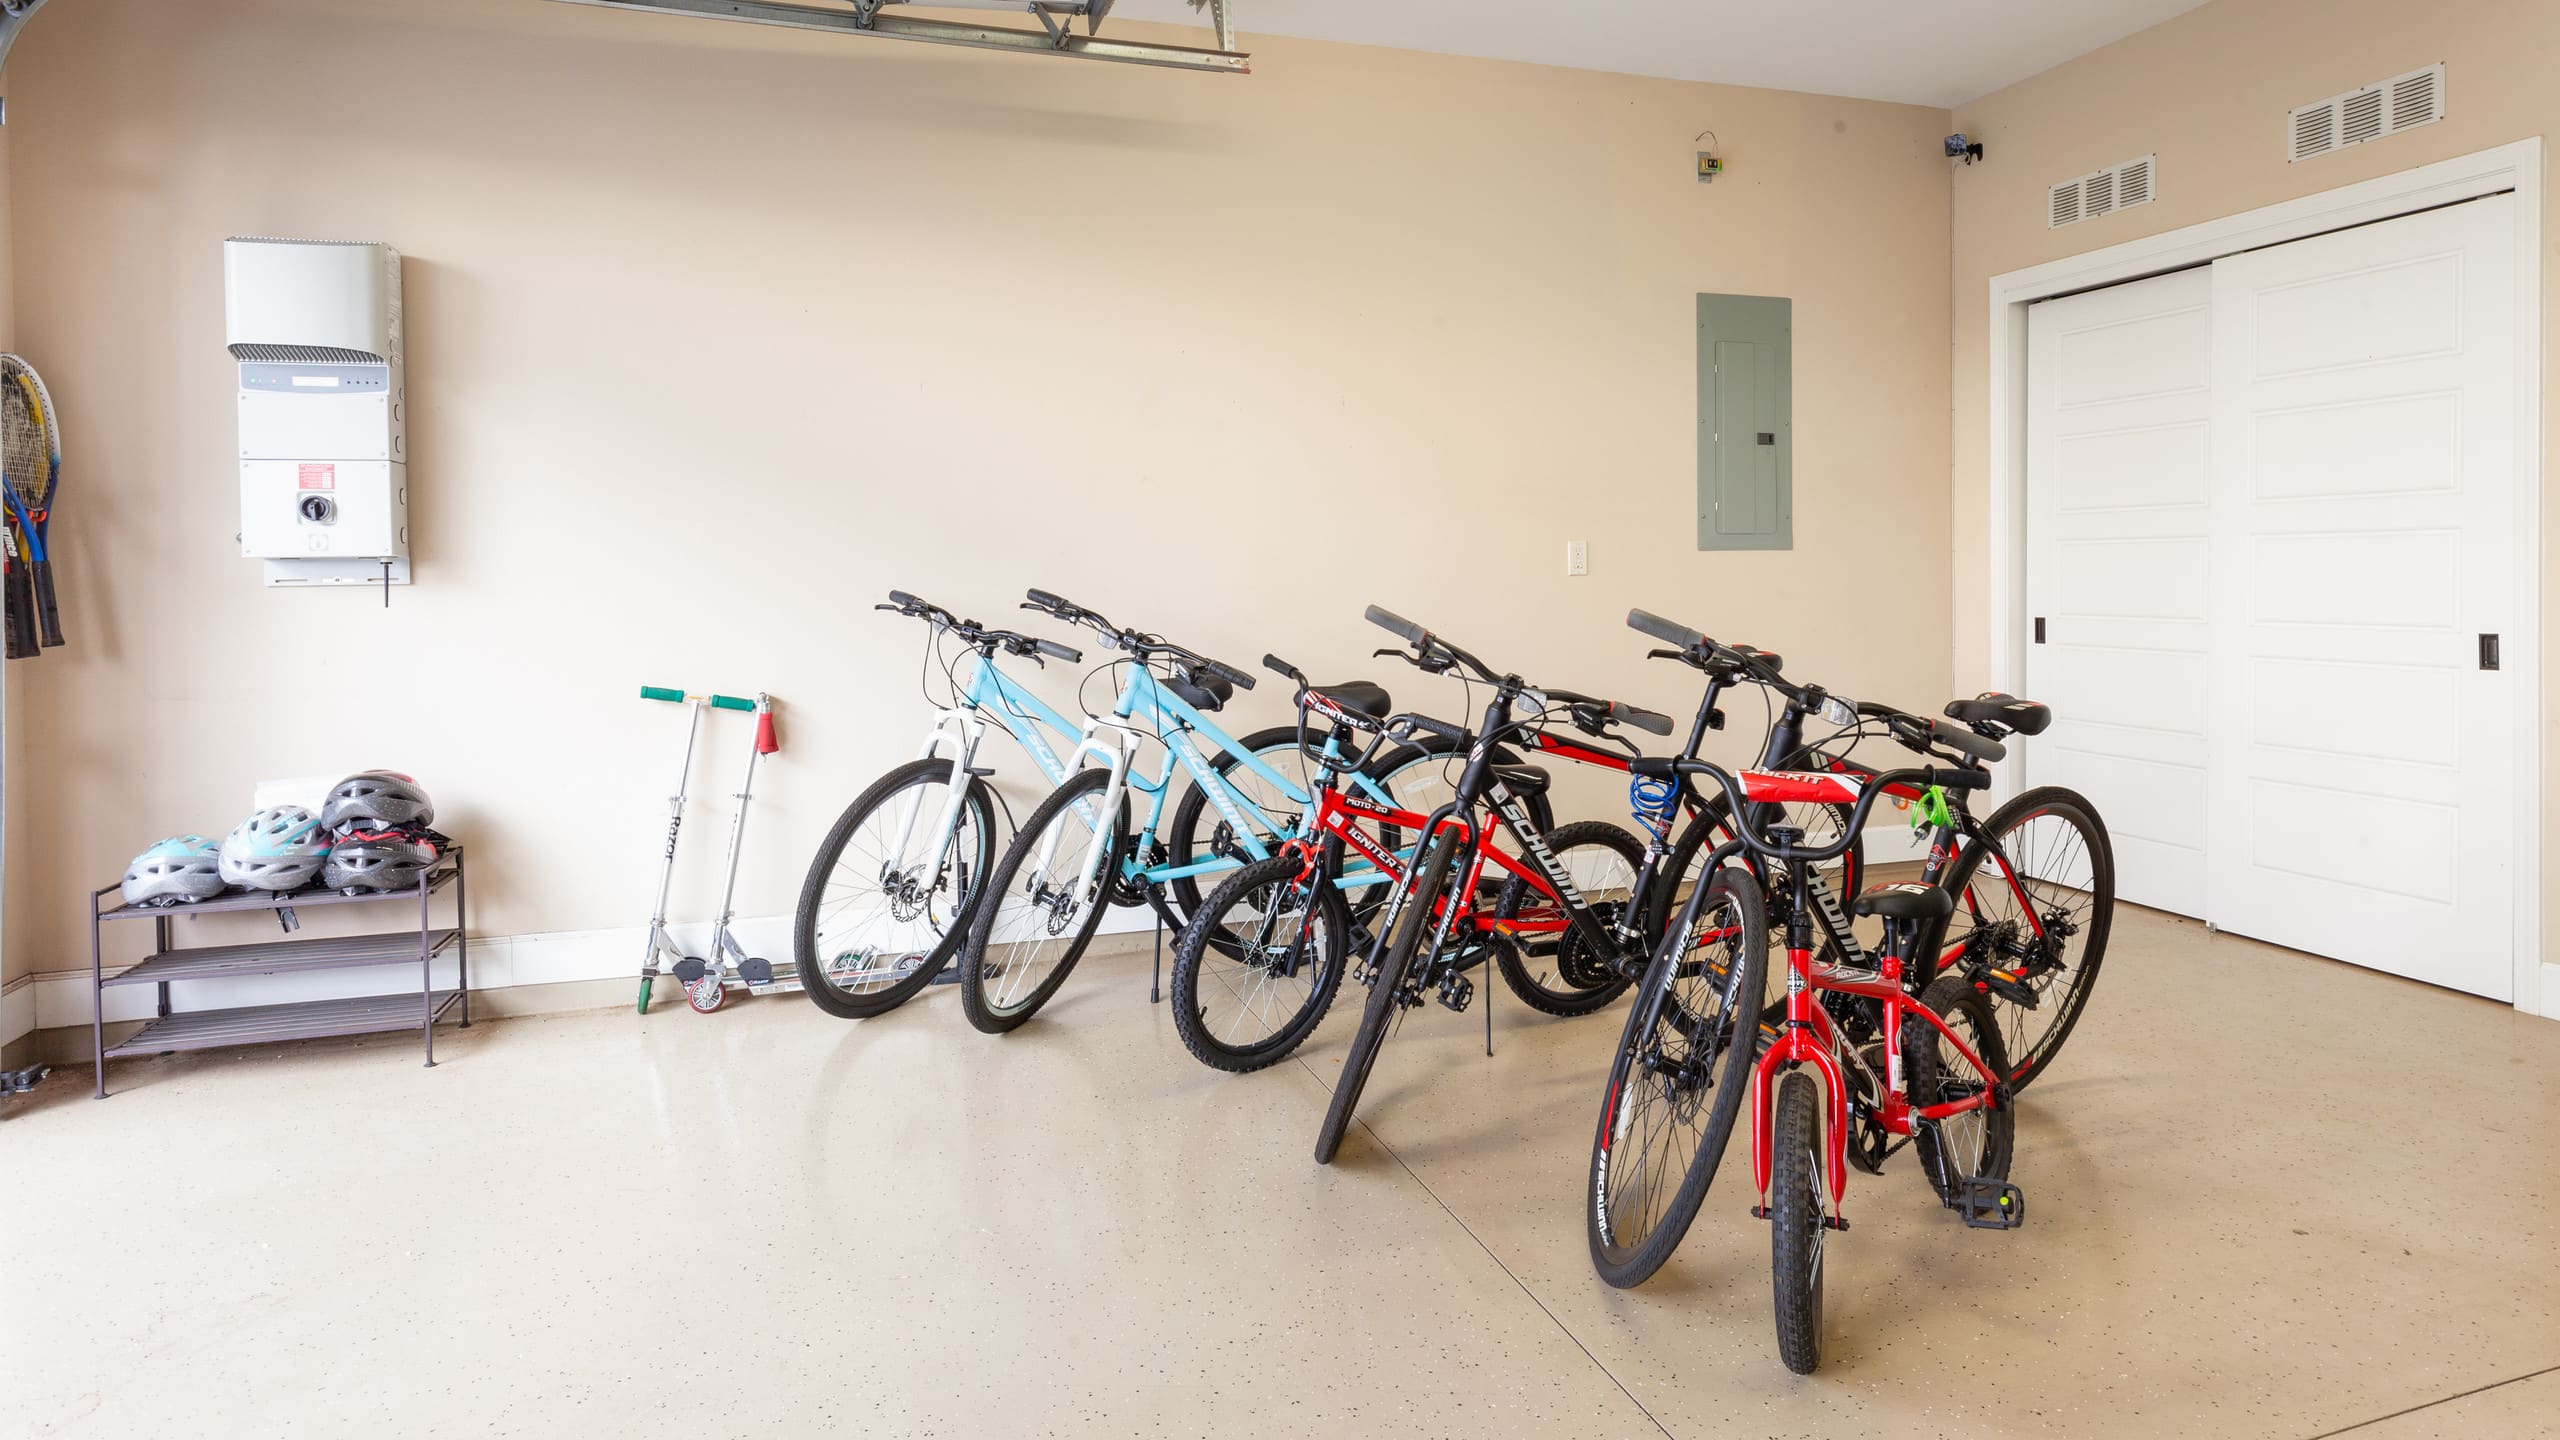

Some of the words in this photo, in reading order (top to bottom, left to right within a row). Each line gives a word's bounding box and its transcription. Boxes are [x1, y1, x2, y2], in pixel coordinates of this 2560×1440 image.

[1313, 701, 1358, 727] IGNITER
[1179, 743, 1249, 834] SCHWINN
[665, 815, 681, 864] Razor
[1347, 827, 1398, 869] IGNITER
[1500, 803, 1589, 911] SCHWINN
[1386, 867, 1413, 928] SCHWINN
[1436, 886, 1461, 947] SCHWINN
[1806, 860, 1867, 962] CHWINN
[1664, 919, 1693, 992] SCHWINN
[2043, 987, 2081, 1052] SCHWINN
[1597, 1170, 1609, 1233] SCHWINN
